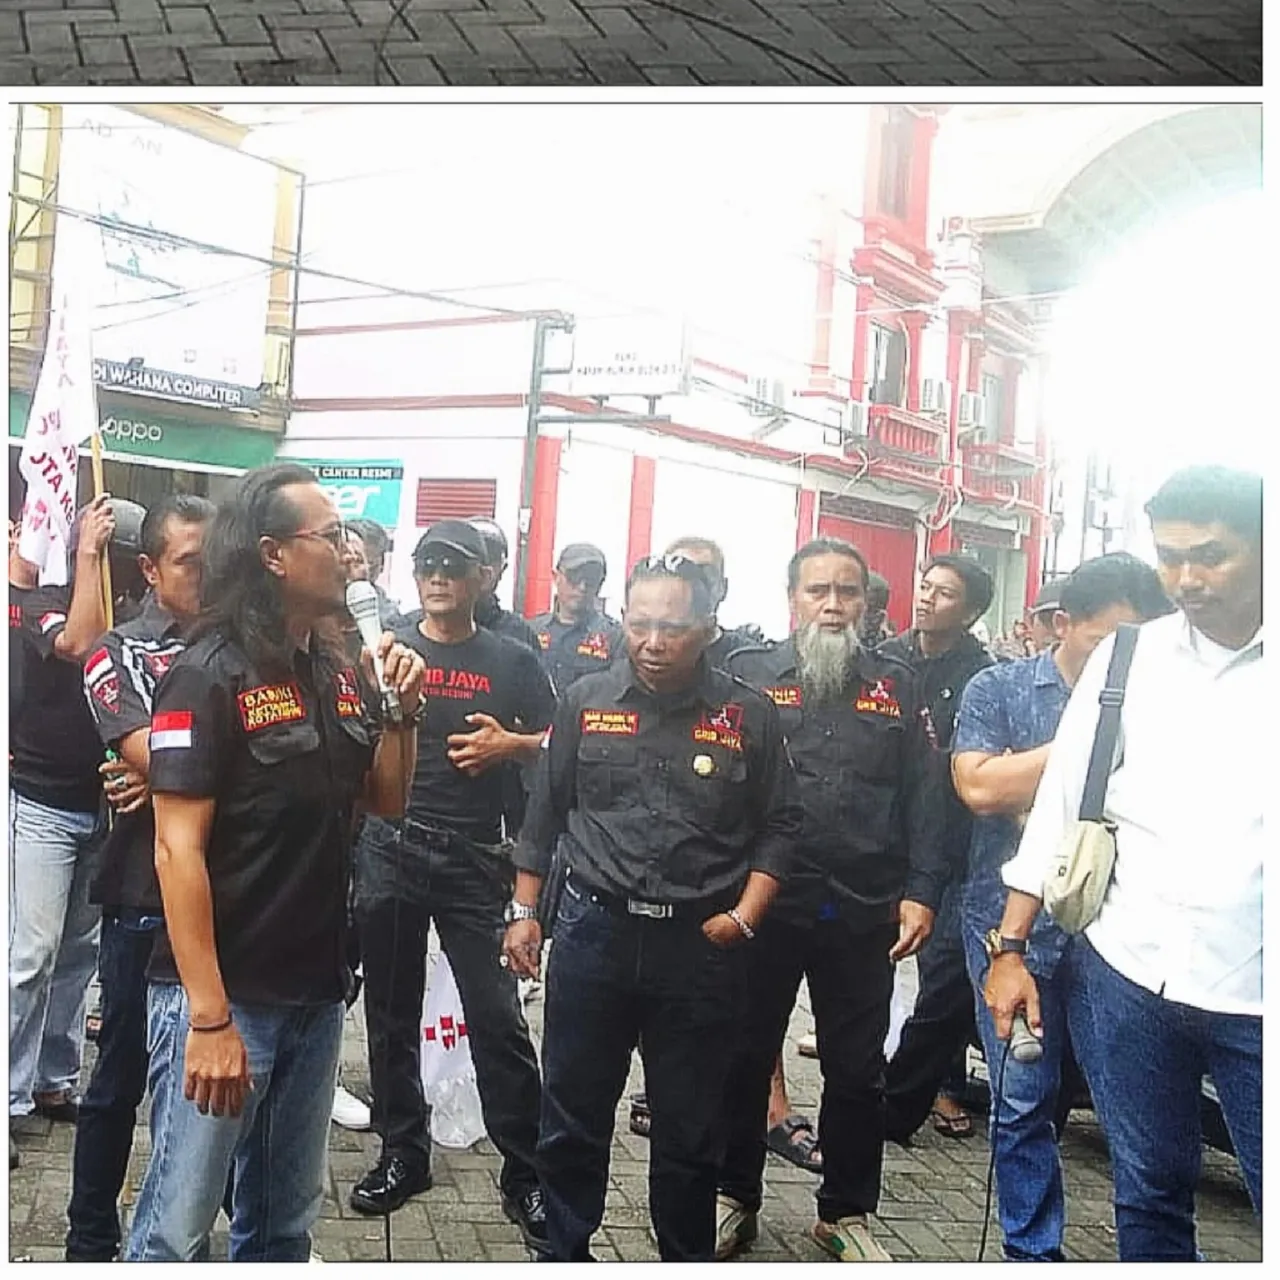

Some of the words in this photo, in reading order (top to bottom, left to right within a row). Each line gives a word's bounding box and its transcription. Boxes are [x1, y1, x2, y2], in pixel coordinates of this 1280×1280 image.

[93, 361, 107, 381] DI
[175, 379, 241, 404] COMPUTER
[445, 669, 491, 693] JAYA
